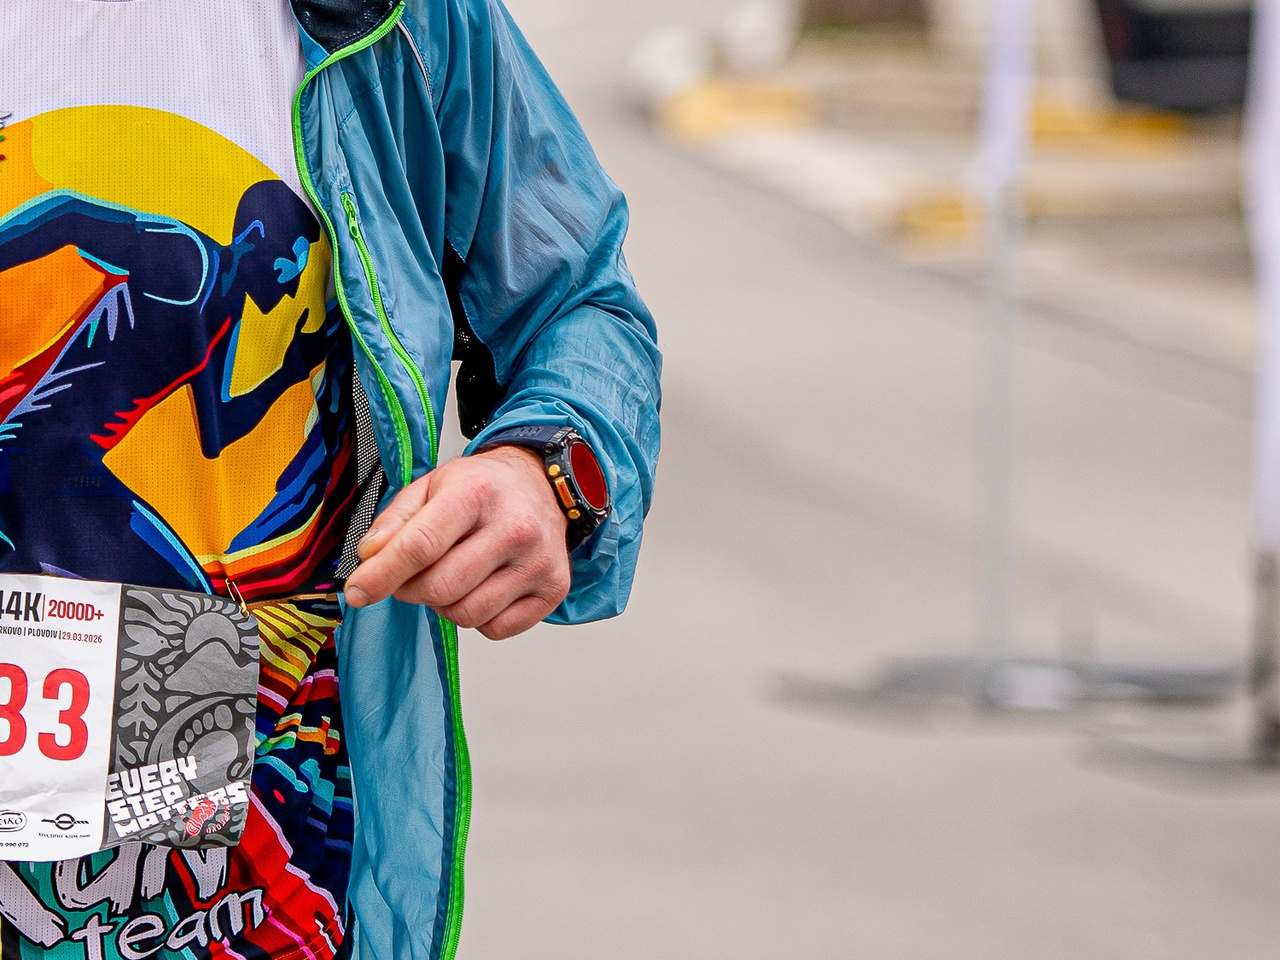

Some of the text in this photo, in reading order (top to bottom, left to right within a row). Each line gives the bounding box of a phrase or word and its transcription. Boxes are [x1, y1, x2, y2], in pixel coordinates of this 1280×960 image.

[47, 599, 105, 622] 2000D+
[26, 628, 58, 639] PLOVDIV
[61, 631, 104, 644] 29.03.2026
[106, 784, 184, 823] STEP
[73, 887, 267, 960] team
